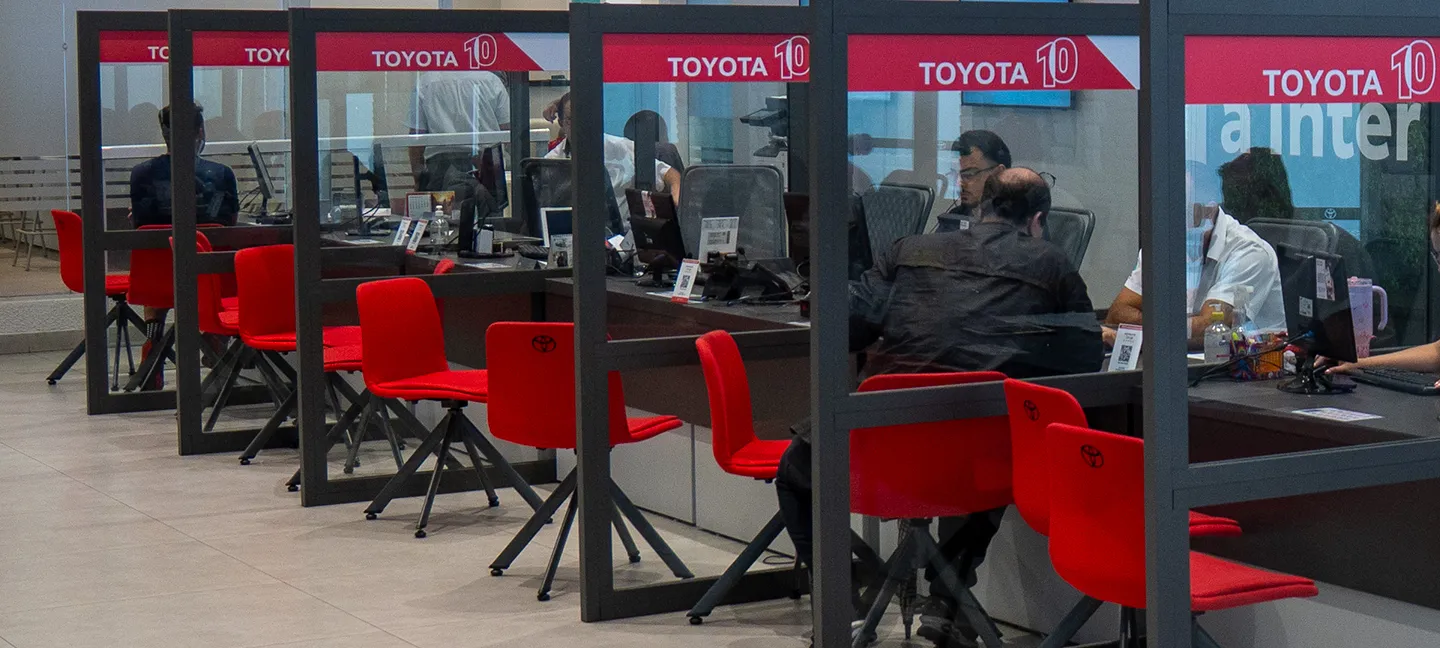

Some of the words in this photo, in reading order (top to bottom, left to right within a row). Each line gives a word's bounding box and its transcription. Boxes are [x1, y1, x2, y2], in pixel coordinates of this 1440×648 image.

[245, 47, 290, 63] TOY
[372, 51, 459, 67] TOYOTA
[463, 33, 498, 70] 10
[667, 56, 768, 77] TOYOTA
[774, 35, 810, 79] 10
[919, 61, 1029, 85] TOYOTA
[1036, 37, 1079, 88] 10
[1262, 69, 1383, 97] TOYOTA
[1390, 39, 1437, 100] 10
